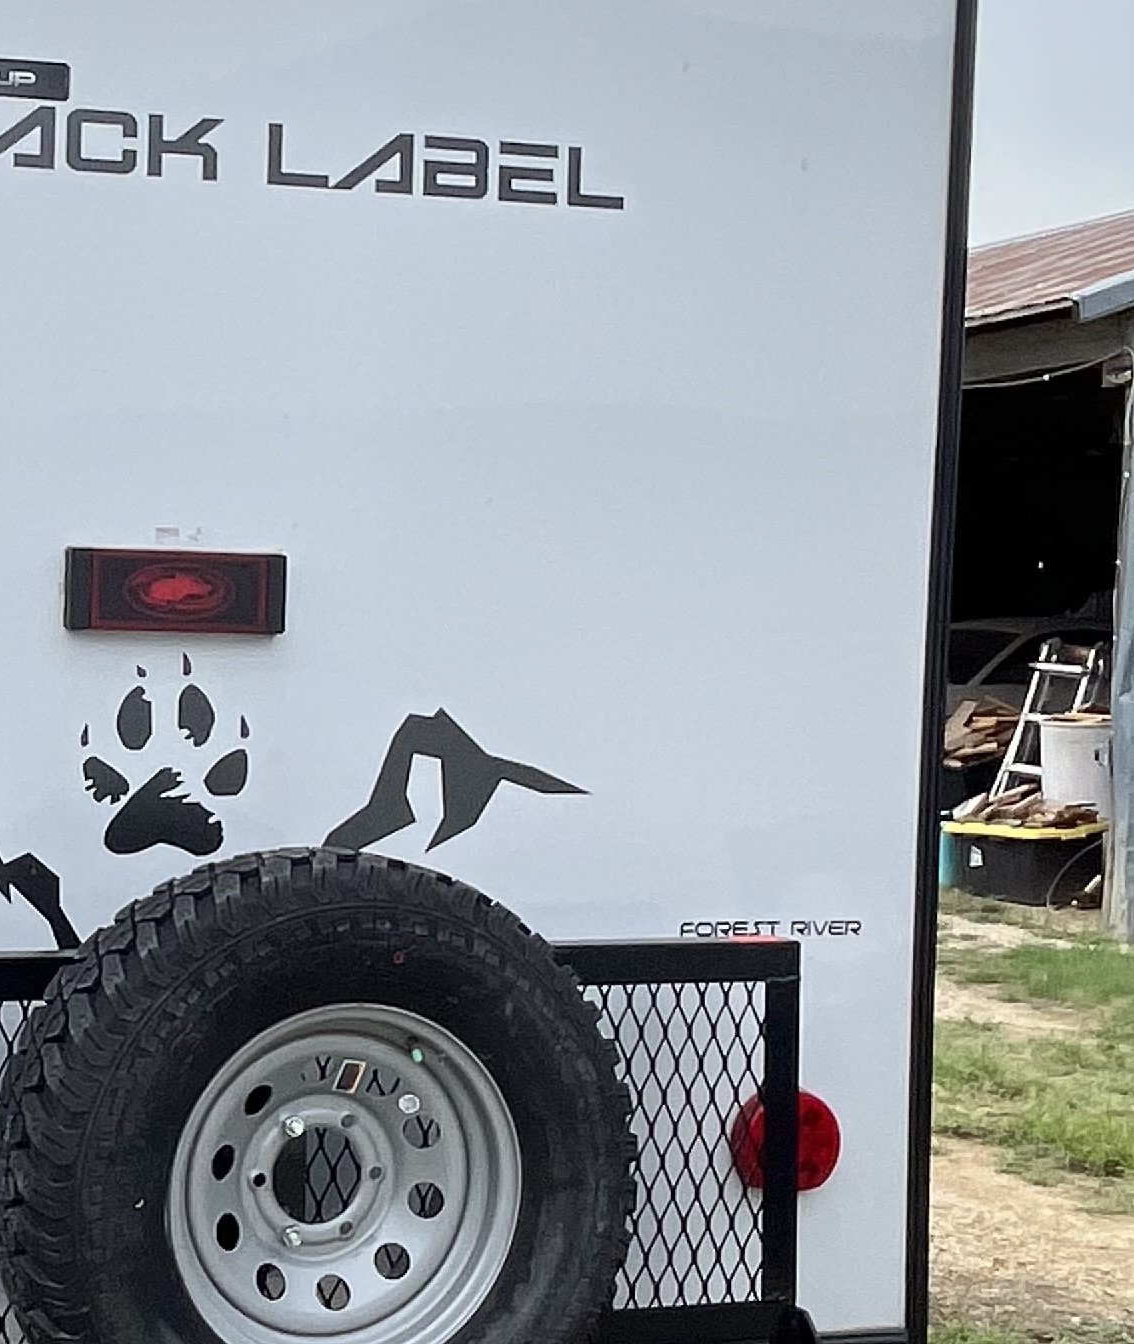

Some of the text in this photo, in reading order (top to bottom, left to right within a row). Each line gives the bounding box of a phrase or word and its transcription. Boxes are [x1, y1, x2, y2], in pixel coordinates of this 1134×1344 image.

[266, 123, 625, 210] LABEL
[680, 920, 862, 938] FOREST RIVER
